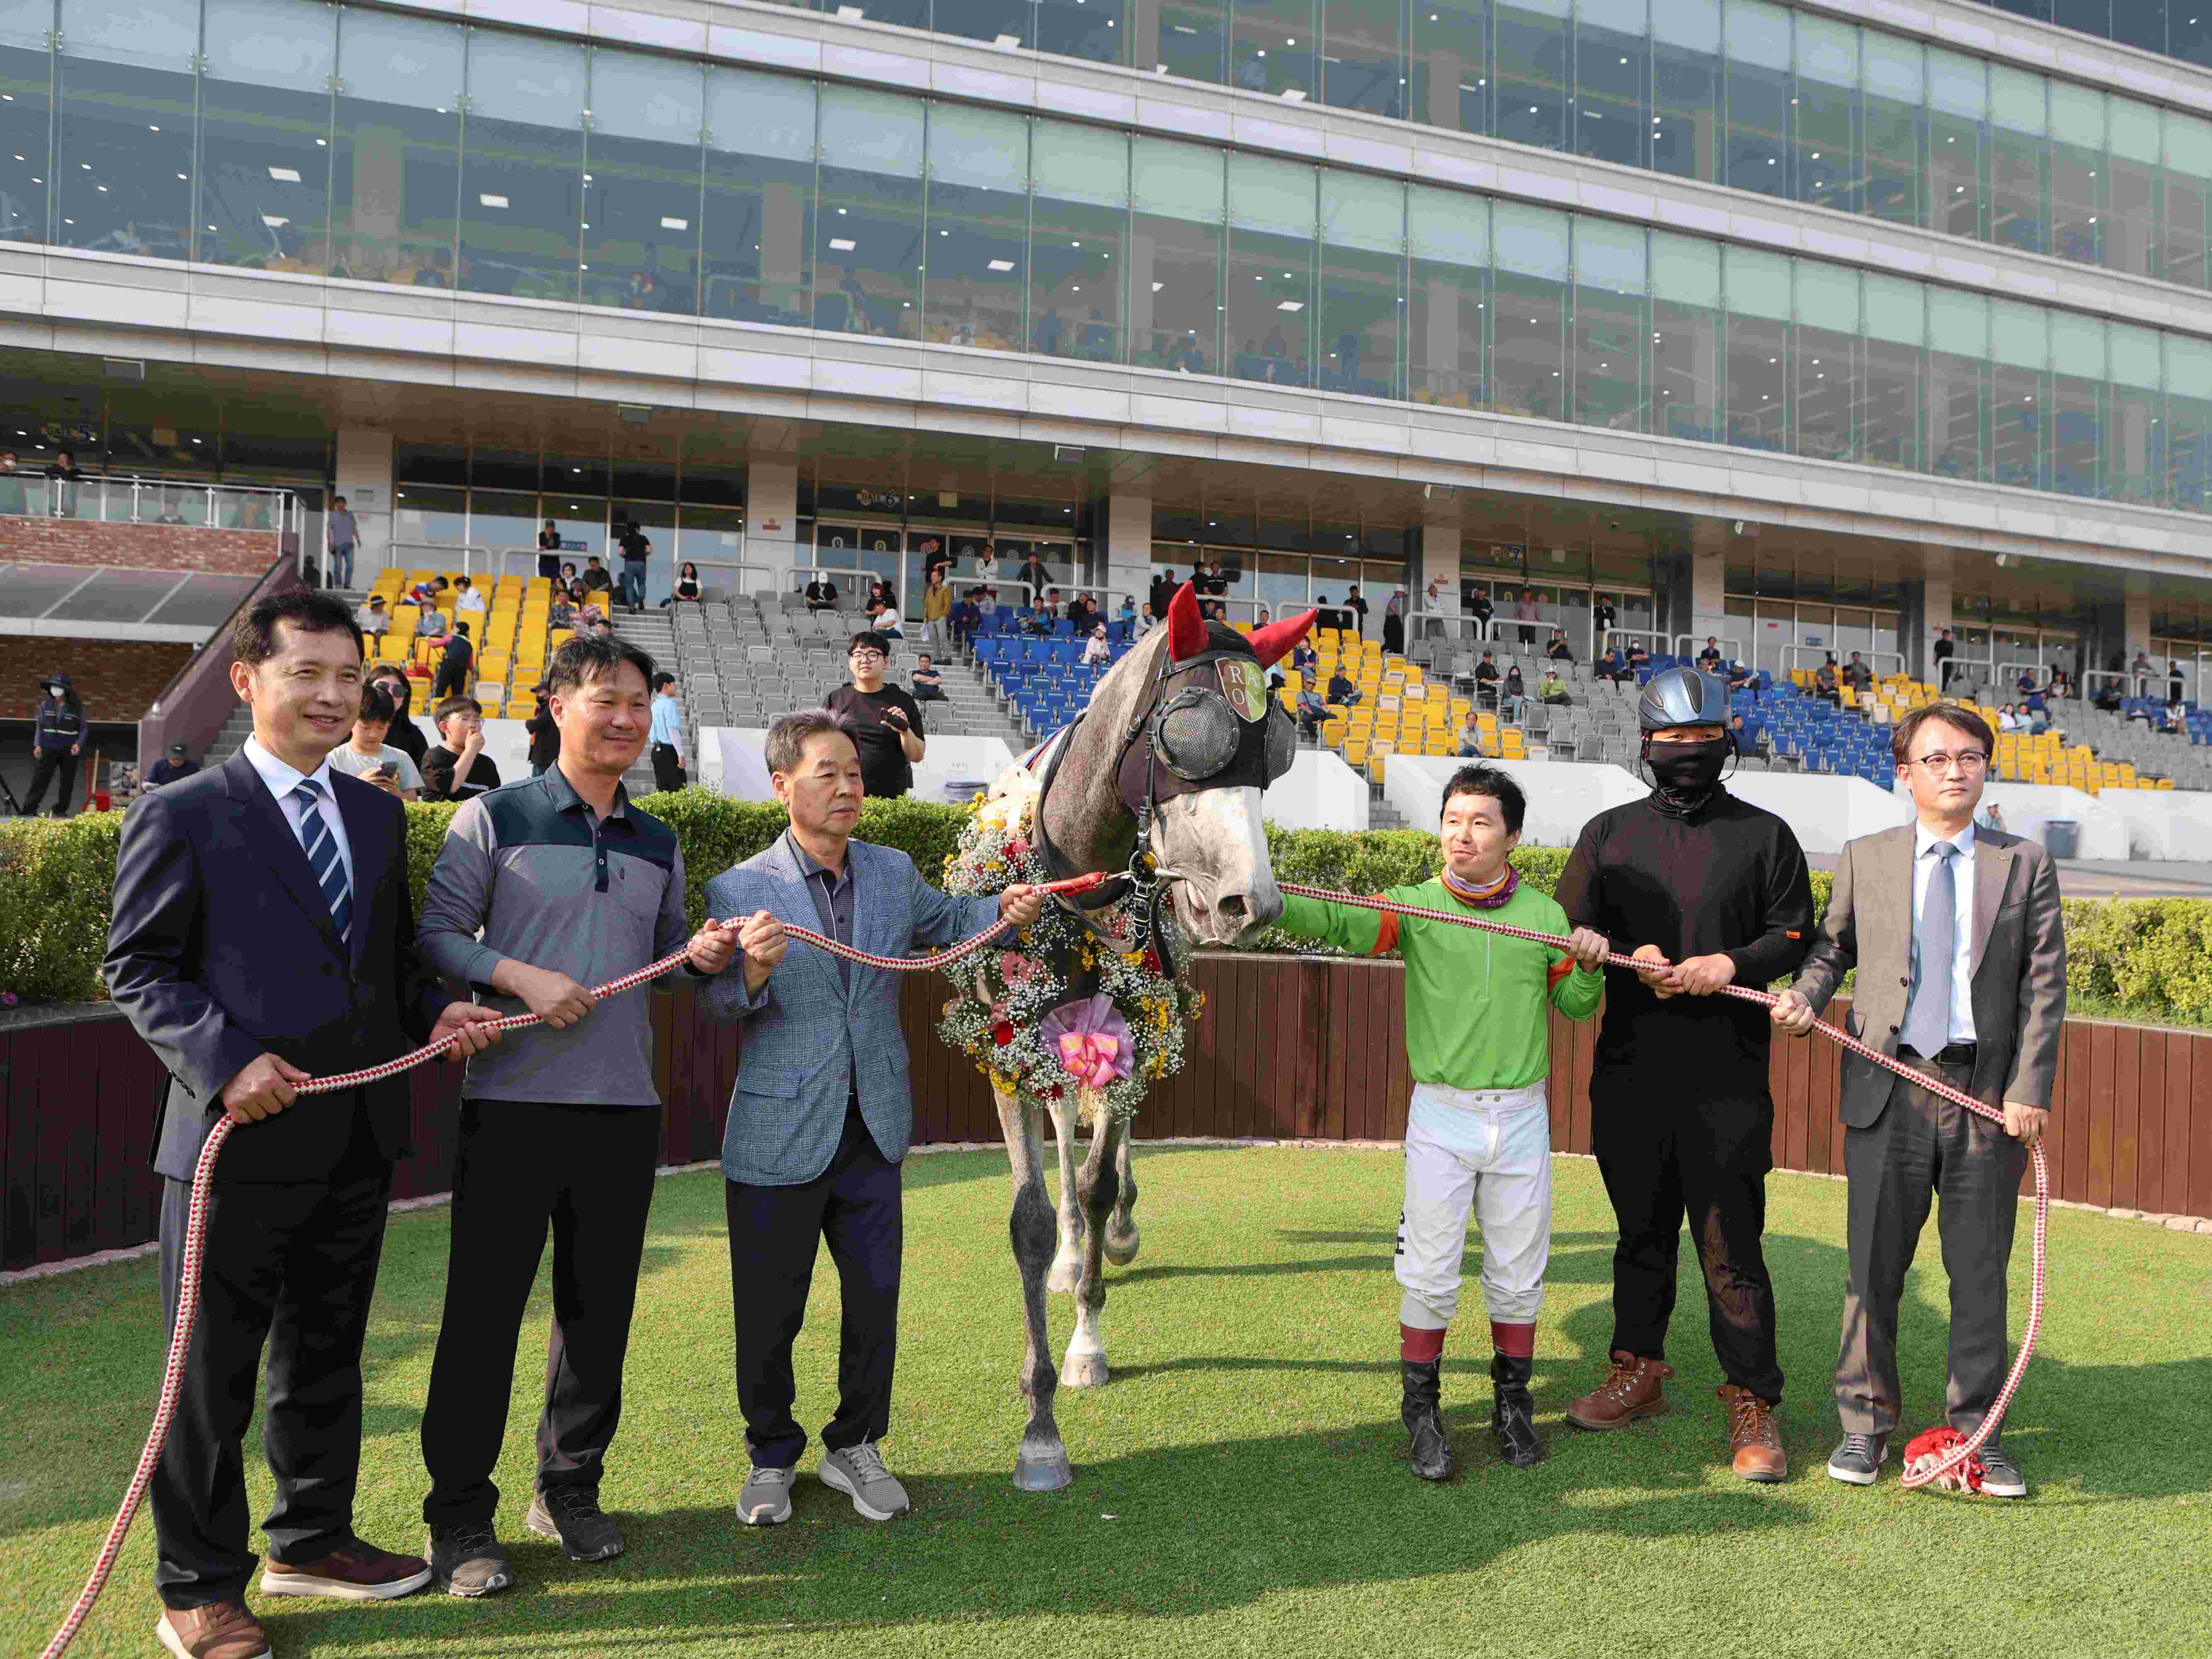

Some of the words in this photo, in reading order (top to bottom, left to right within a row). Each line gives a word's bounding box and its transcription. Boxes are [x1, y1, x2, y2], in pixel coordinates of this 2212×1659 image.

[885, 490, 896, 507] 6
[1512, 547, 1520, 562] 7
[1228, 666, 1261, 687] RA
